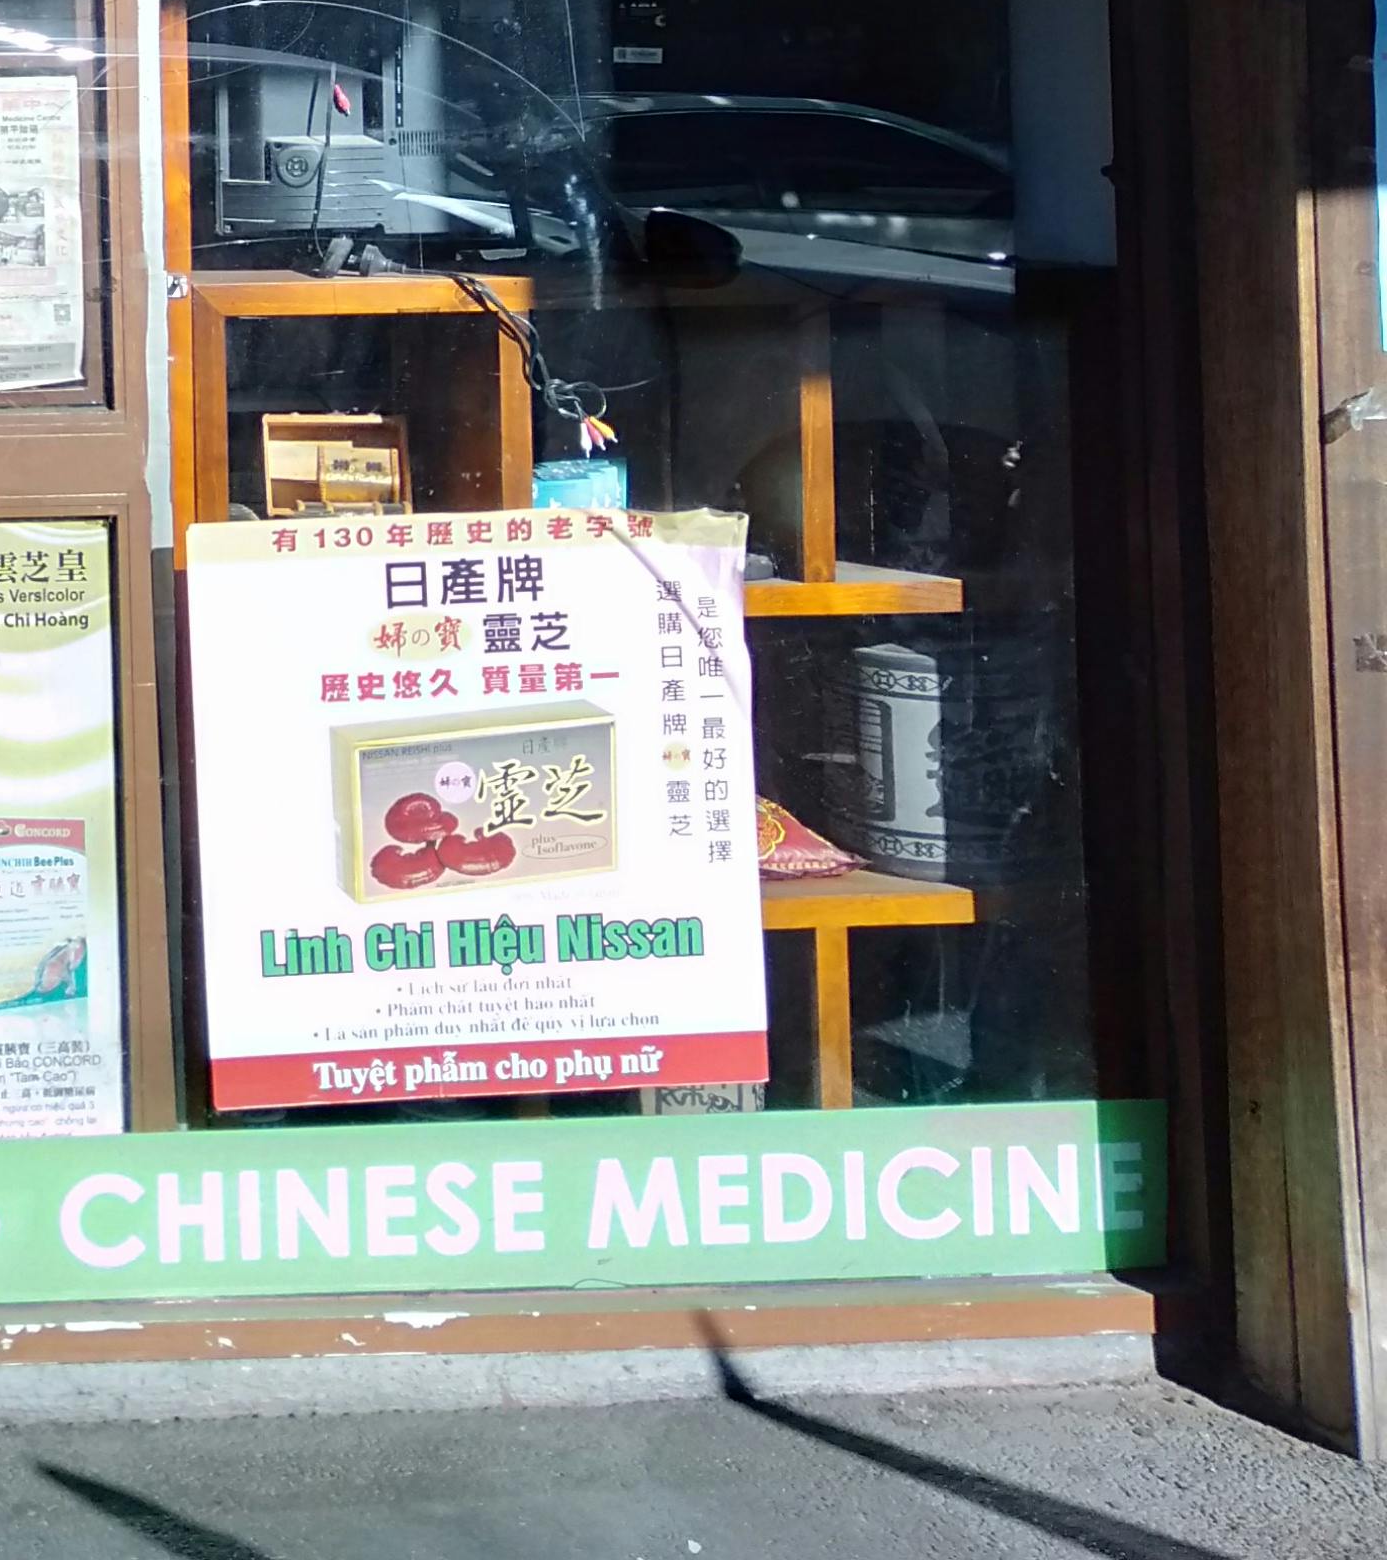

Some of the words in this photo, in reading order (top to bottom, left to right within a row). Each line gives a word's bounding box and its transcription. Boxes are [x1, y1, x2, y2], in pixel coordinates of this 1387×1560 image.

[384, 554, 545, 609] 日產牌
[3, 612, 30, 628] Chi
[34, 611, 89, 631] Hoàng
[482, 611, 571, 654] 靈芝
[320, 668, 459, 704] 歷史悠久
[481, 662, 620, 695] 質量第一
[696, 596, 734, 864] 是您唯一最好的選擇
[260, 926, 354, 978] Linh
[364, 920, 436, 971] Chi
[447, 913, 546, 976] Hiệu
[555, 913, 705, 963] Nissan
[313, 1057, 399, 1092] Tuyệt
[496, 1049, 547, 1079] cho
[557, 1049, 613, 1084] phụ
[619, 1044, 665, 1075] nữ
[59, 1160, 545, 1270] CHINESE
[586, 1140, 1145, 1252] MEDICINE
